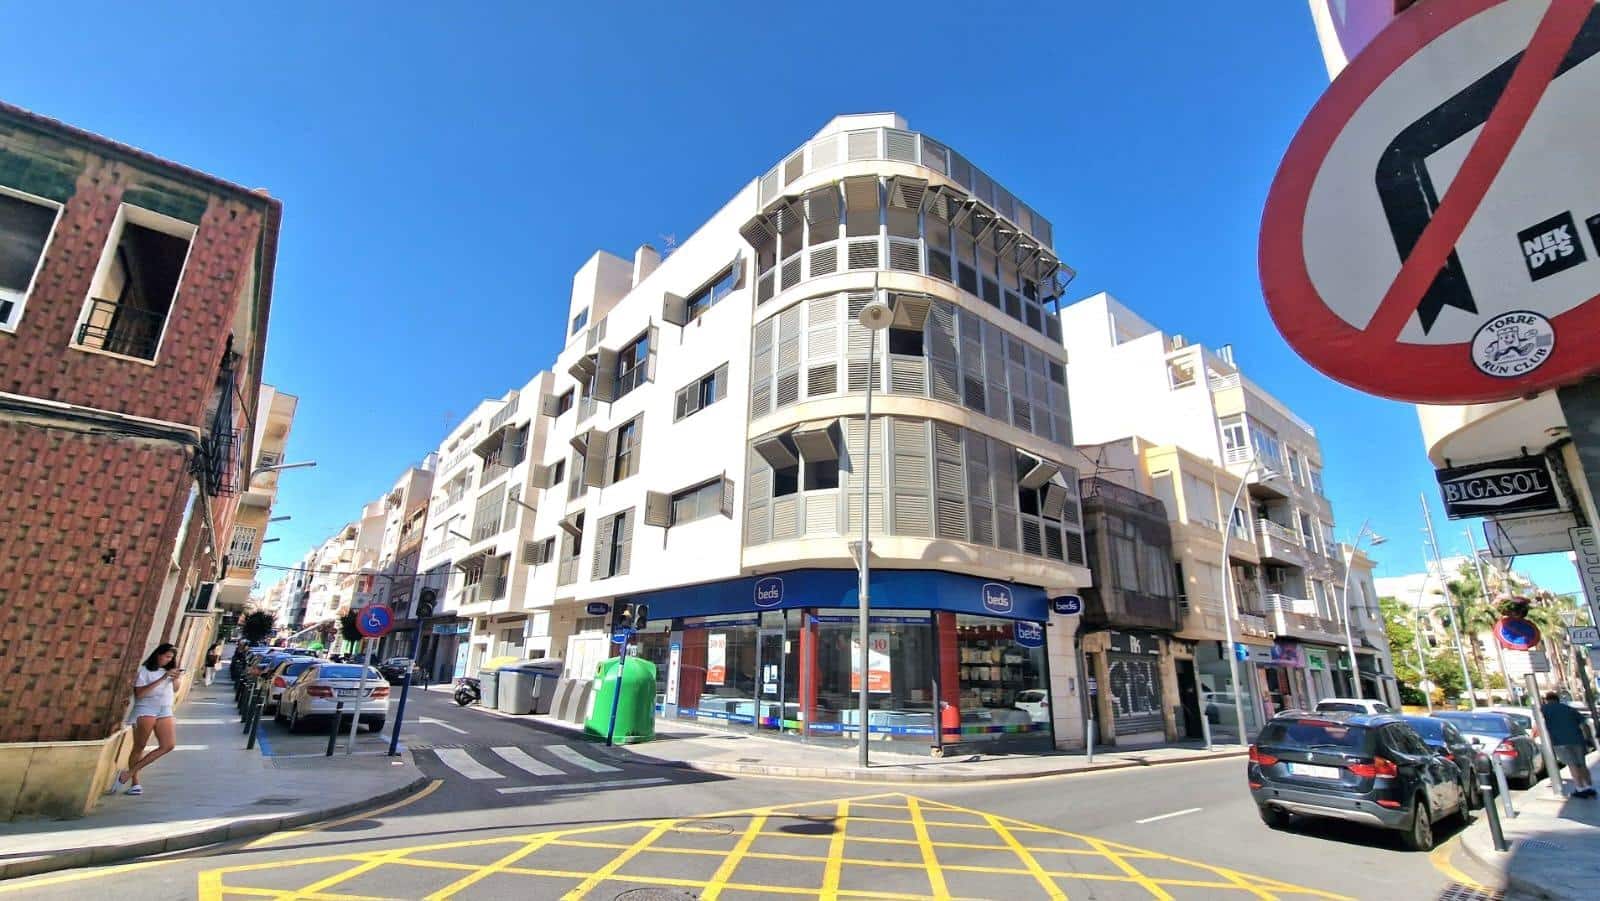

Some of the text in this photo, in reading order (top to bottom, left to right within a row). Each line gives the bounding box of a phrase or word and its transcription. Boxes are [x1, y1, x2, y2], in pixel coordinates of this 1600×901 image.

[1523, 224, 1571, 256] NEK
[1530, 240, 1575, 269] DTS
[1485, 315, 1537, 334] TORRE
[1482, 348, 1547, 374] RUN CLUB
[1444, 472, 1548, 502] BIGASOL
